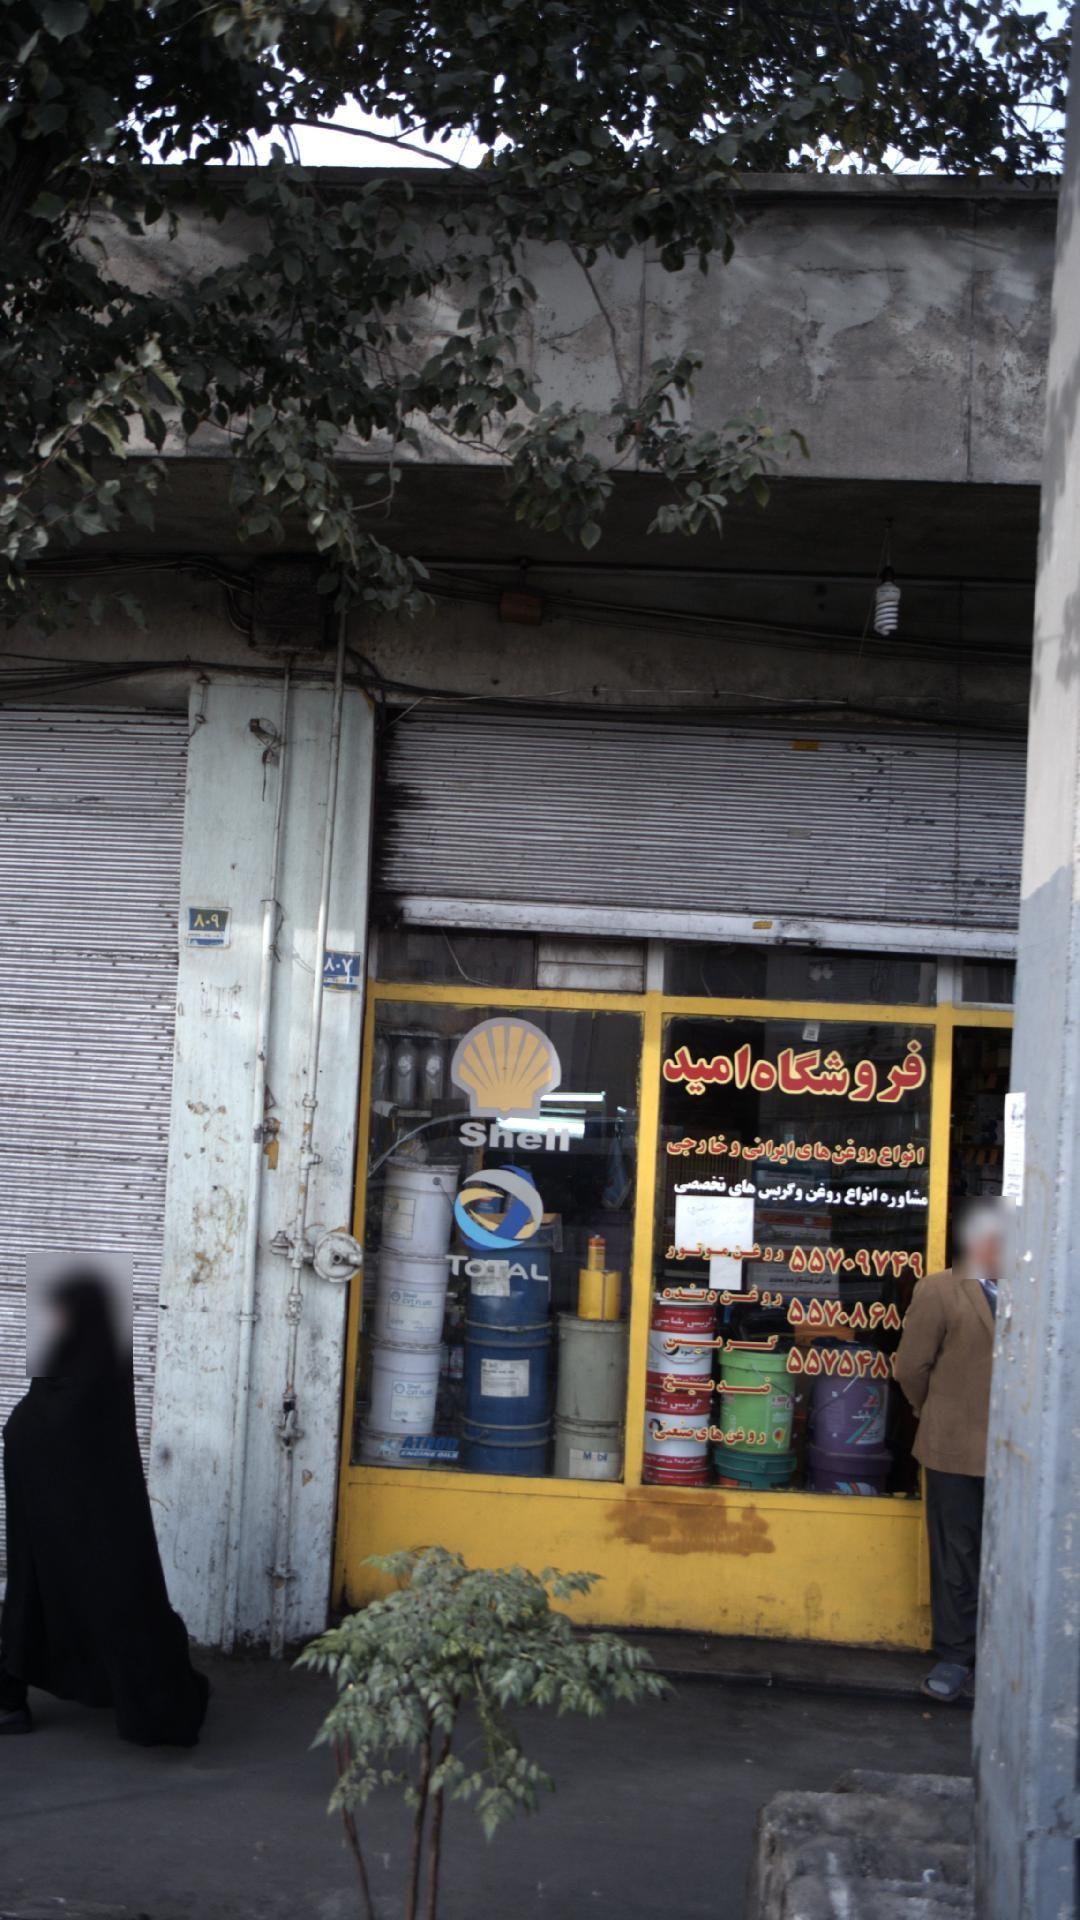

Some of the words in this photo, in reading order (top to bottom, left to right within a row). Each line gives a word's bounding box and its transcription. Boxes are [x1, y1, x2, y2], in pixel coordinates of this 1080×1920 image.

[194, 913, 219, 928] ۸۰۹
[663, 1043, 750, 1095] امید
[751, 1040, 926, 1102] فروشگاه
[458, 1122, 570, 1151] Shell
[666, 1134, 728, 1156] خارجی
[742, 1137, 795, 1164] ایرانی
[795, 1141, 831, 1161] های
[832, 1139, 877, 1164] روغن
[878, 1143, 925, 1167] انواع
[674, 1175, 727, 1193] تخصصی
[728, 1179, 756, 1197] های
[805, 1182, 841, 1204] روغن
[844, 1186, 878, 1206] انواع
[880, 1189, 929, 1208] مشاوره
[665, 1242, 728, 1260] موتور
[732, 1241, 784, 1262] روغن
[445, 1254, 549, 1281] TOTAL
[789, 1246, 923, 1279] ۵۵۷۰۹۷۴۹
[662, 1282, 718, 1303] دنده
[720, 1284, 783, 1306] روغن
[787, 1297, 907, 1330] ۵۵۷۰۸۶۸
[664, 1334, 779, 1352] گریس
[662, 1374, 715, 1396] یخ
[716, 1376, 772, 1394] ضد
[653, 1420, 695, 1441] صنعتی
[695, 1425, 724, 1442] های
[724, 1426, 767, 1445] روغن
[583, 1450, 608, 1462] Mbil
